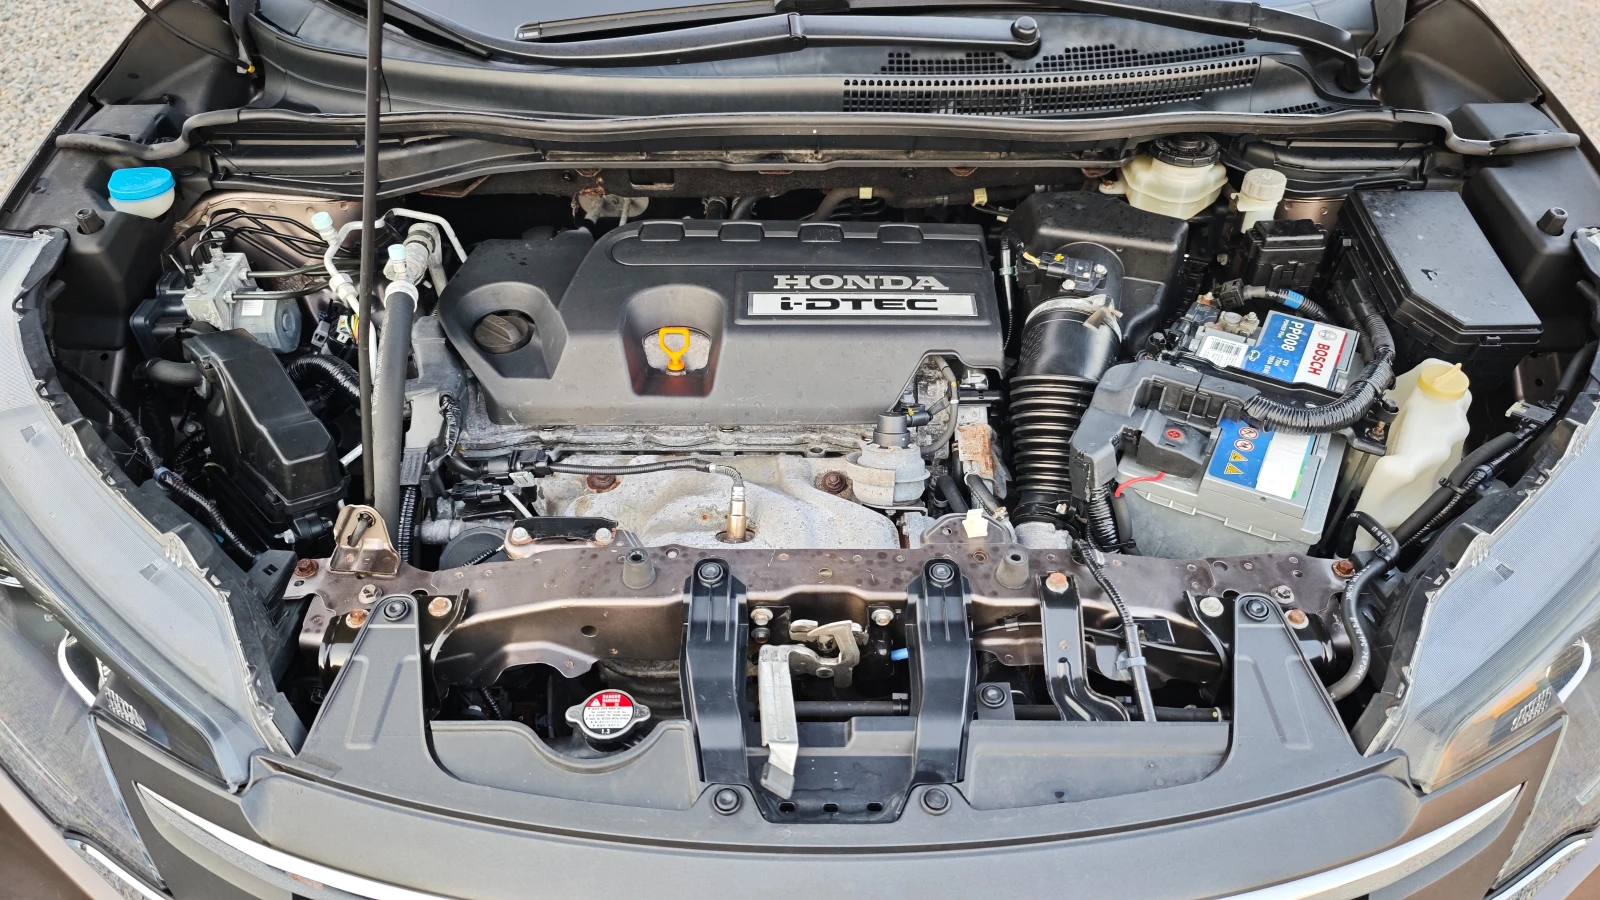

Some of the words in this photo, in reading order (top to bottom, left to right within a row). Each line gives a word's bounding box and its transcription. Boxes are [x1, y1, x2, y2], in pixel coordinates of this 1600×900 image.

[773, 274, 950, 291] HONDA
[780, 296, 939, 311] i-DTEC
[1282, 321, 1305, 352] PP008
[1307, 343, 1331, 376] BOSCH
